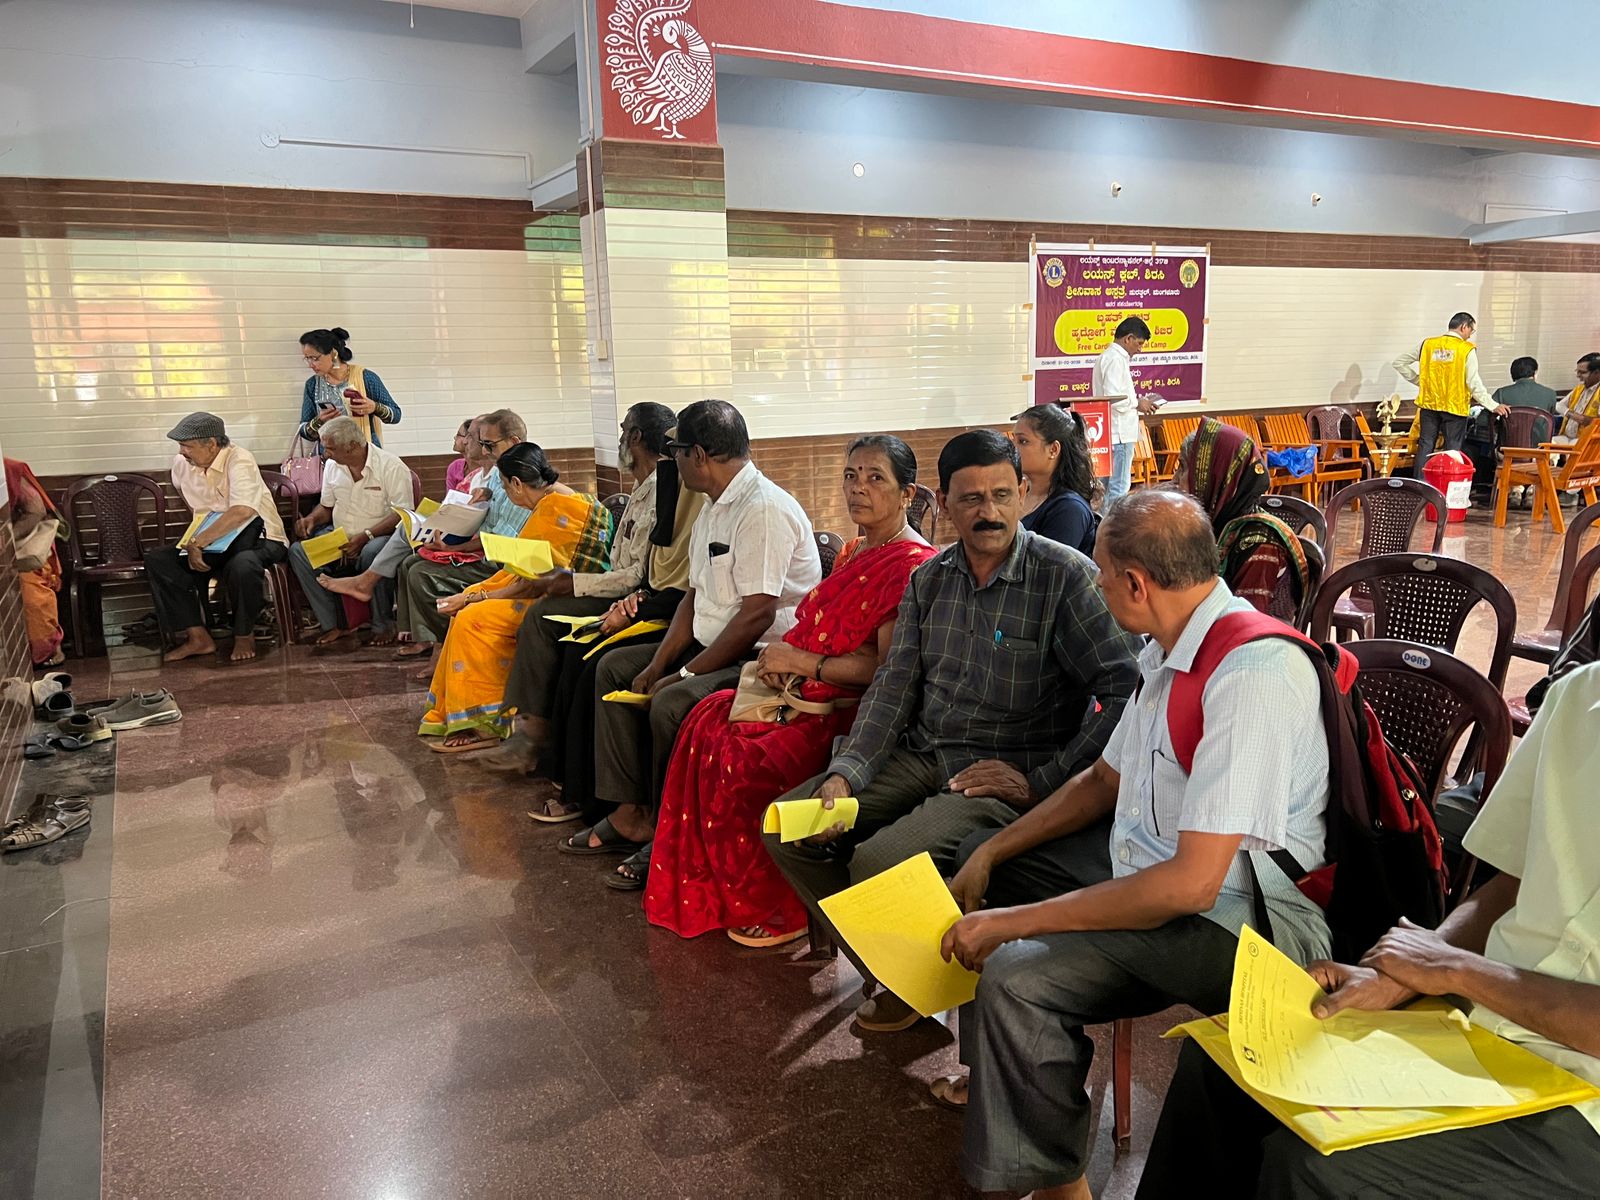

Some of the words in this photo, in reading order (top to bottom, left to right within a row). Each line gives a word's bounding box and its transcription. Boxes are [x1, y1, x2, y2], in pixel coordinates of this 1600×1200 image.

[1051, 266, 1059, 278] L
[1083, 268, 1115, 283] ಲಯನ್ಸ್
[1144, 268, 1165, 280] ಶಿರಸಿ
[1066, 285, 1102, 299] ಶ್ರೀನಿವಾಸ
[1096, 312, 1122, 326] ಬೃಹತ್
[1071, 327, 1106, 342] ಹೃದ್ರೋಗ
[1154, 325, 1173, 335] ಶಿಬಿರ
[1077, 343, 1092, 351] Free
[1150, 341, 1167, 349] Camp
[1167, 377, 1181, 386] ಶಿರಸಿ
